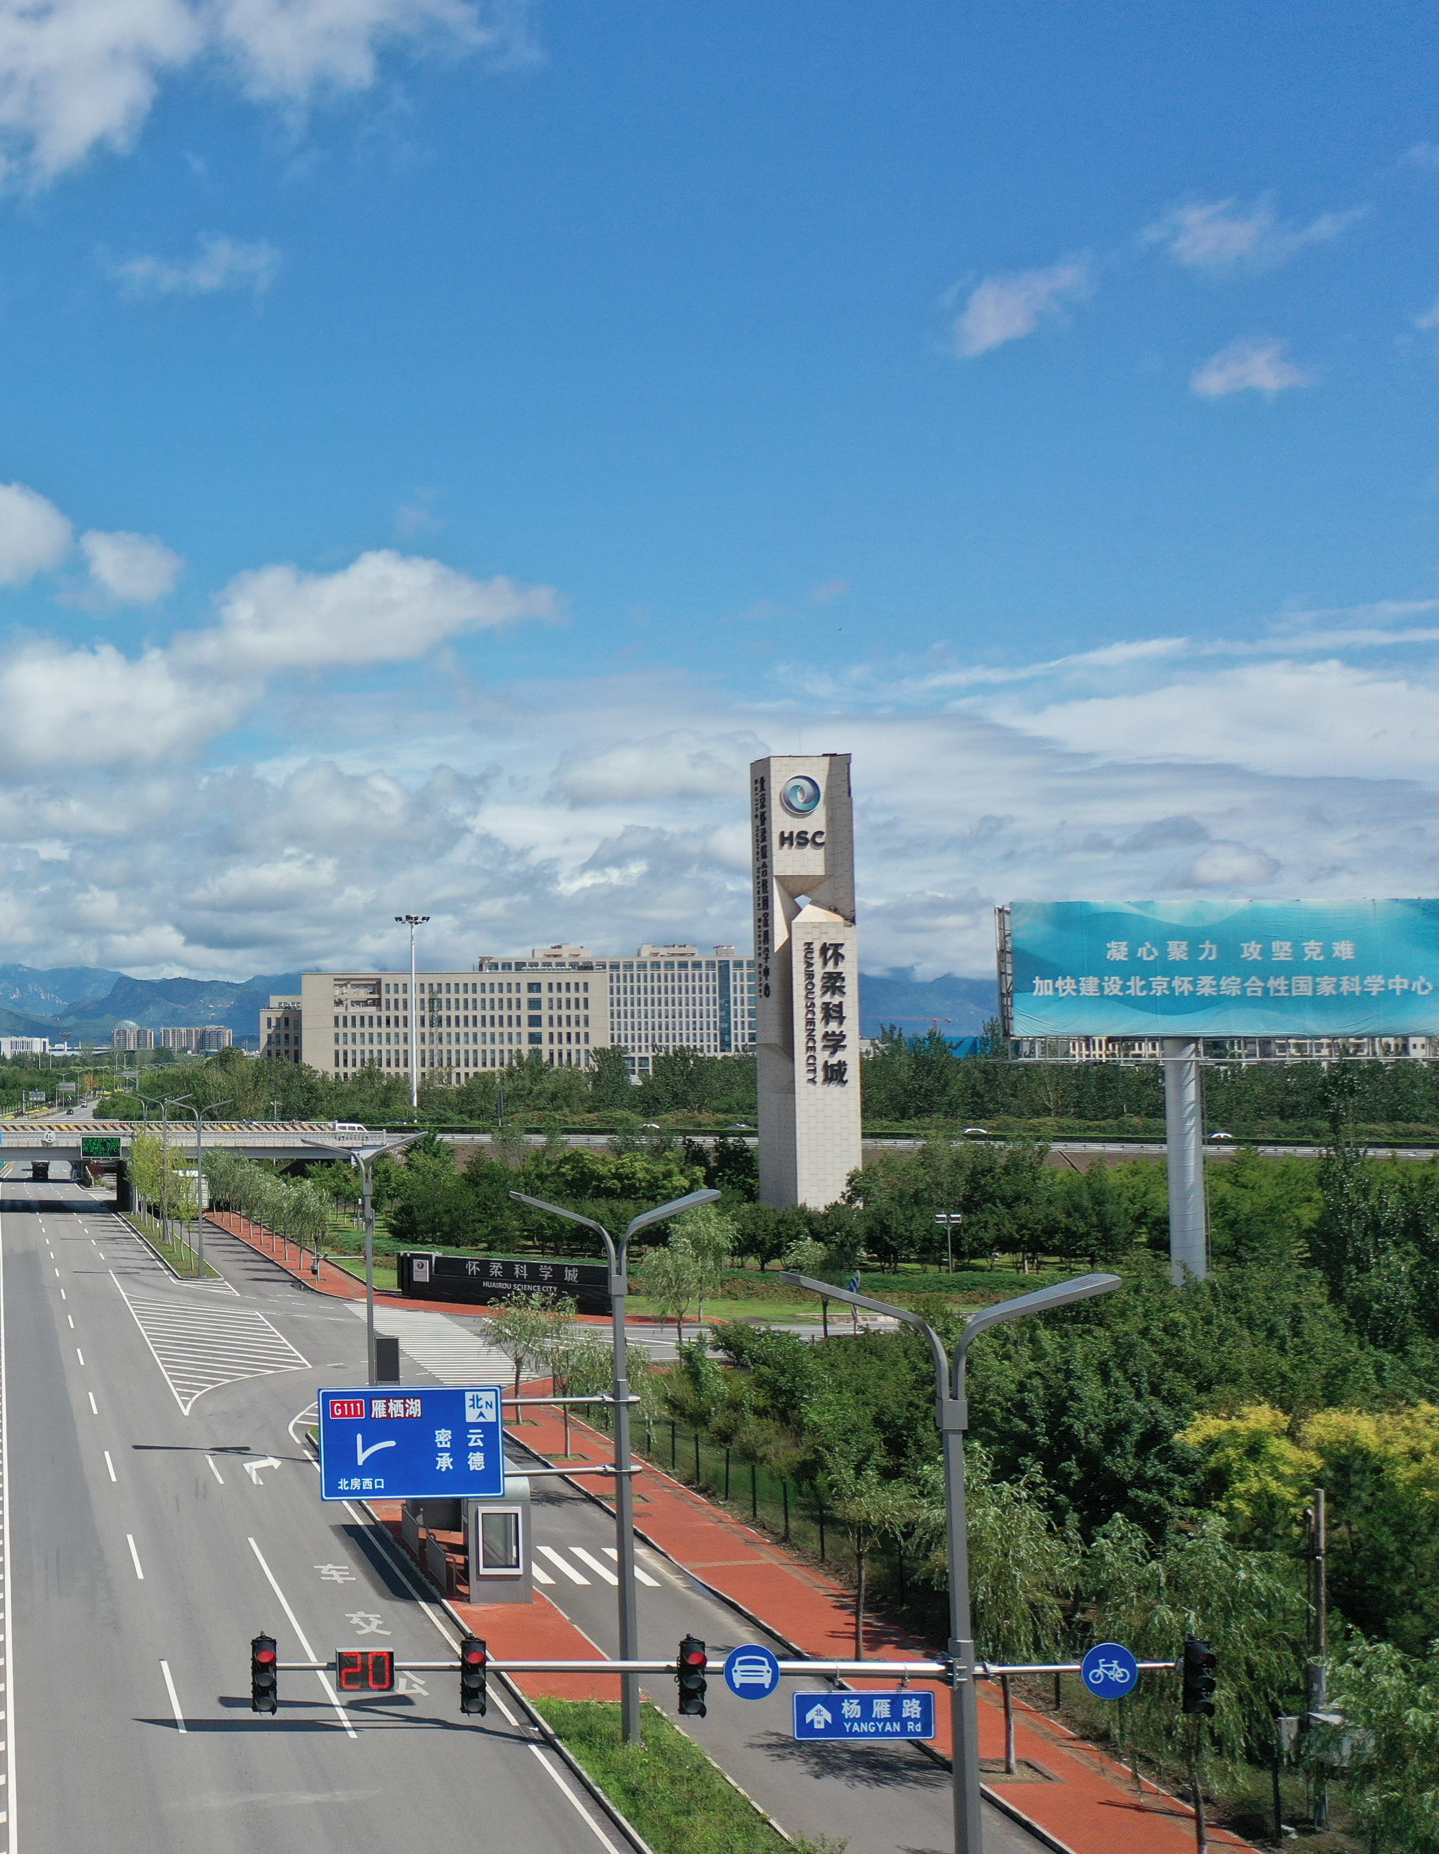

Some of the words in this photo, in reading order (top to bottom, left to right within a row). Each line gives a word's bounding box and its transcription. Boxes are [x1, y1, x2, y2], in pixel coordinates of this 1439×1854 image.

[778, 830, 825, 849] HSC
[1106, 941, 1218, 961] 凝心聚力
[1240, 941, 1357, 961] 攻坚克难
[1032, 975, 1434, 997] 加快建设北京怀柔综合性国家科学中心
[819, 941, 848, 1087] 怀柔科学城
[465, 1260, 579, 1283] 怀柔科学城
[482, 1281, 512, 1289] HUAIROU
[512, 1283, 541, 1291] SCIENCE
[333, 1403, 362, 1416] G111
[371, 1398, 422, 1418] 雁栖湖
[469, 1394, 483, 1409] 北
[485, 1401, 493, 1409] N
[435, 1429, 484, 1448] 密云
[435, 1452, 485, 1472] 承德
[338, 1478, 385, 1490] 北房西口
[341, 1651, 391, 1690] 20
[841, 1698, 922, 1719] 杨雁路
[843, 1721, 901, 1732] YANGYAN
[907, 1721, 922, 1732] Rd
